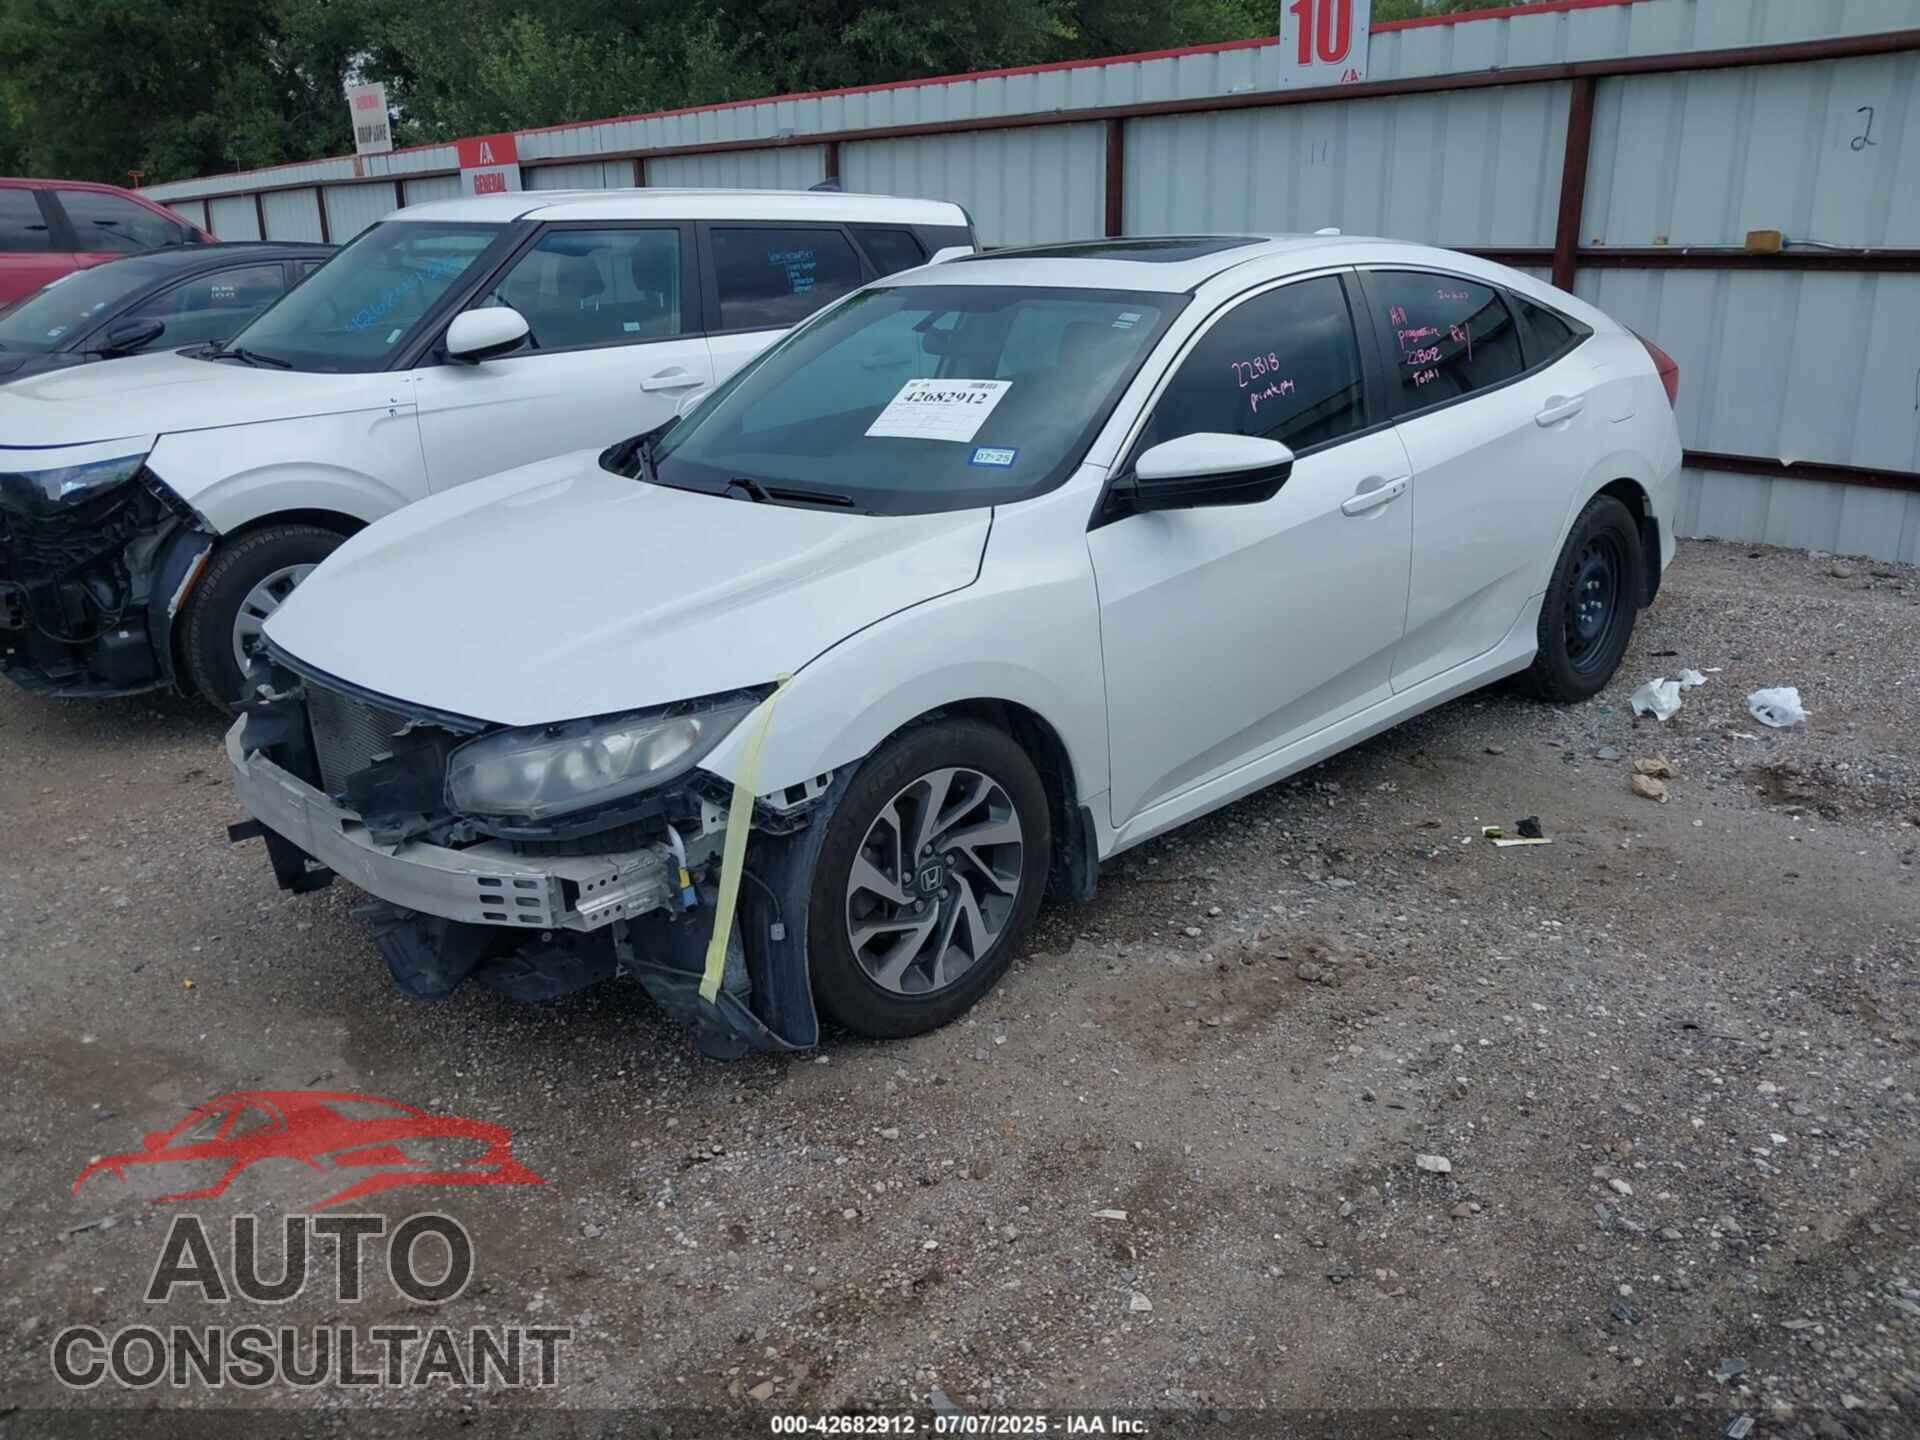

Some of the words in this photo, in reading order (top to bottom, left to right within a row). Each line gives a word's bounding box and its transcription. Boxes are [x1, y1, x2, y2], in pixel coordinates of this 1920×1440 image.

[1290, 0, 1352, 65] 10
[1850, 106, 1879, 151] 2
[1231, 352, 1280, 388] 22818
[903, 391, 988, 405] 42682912
